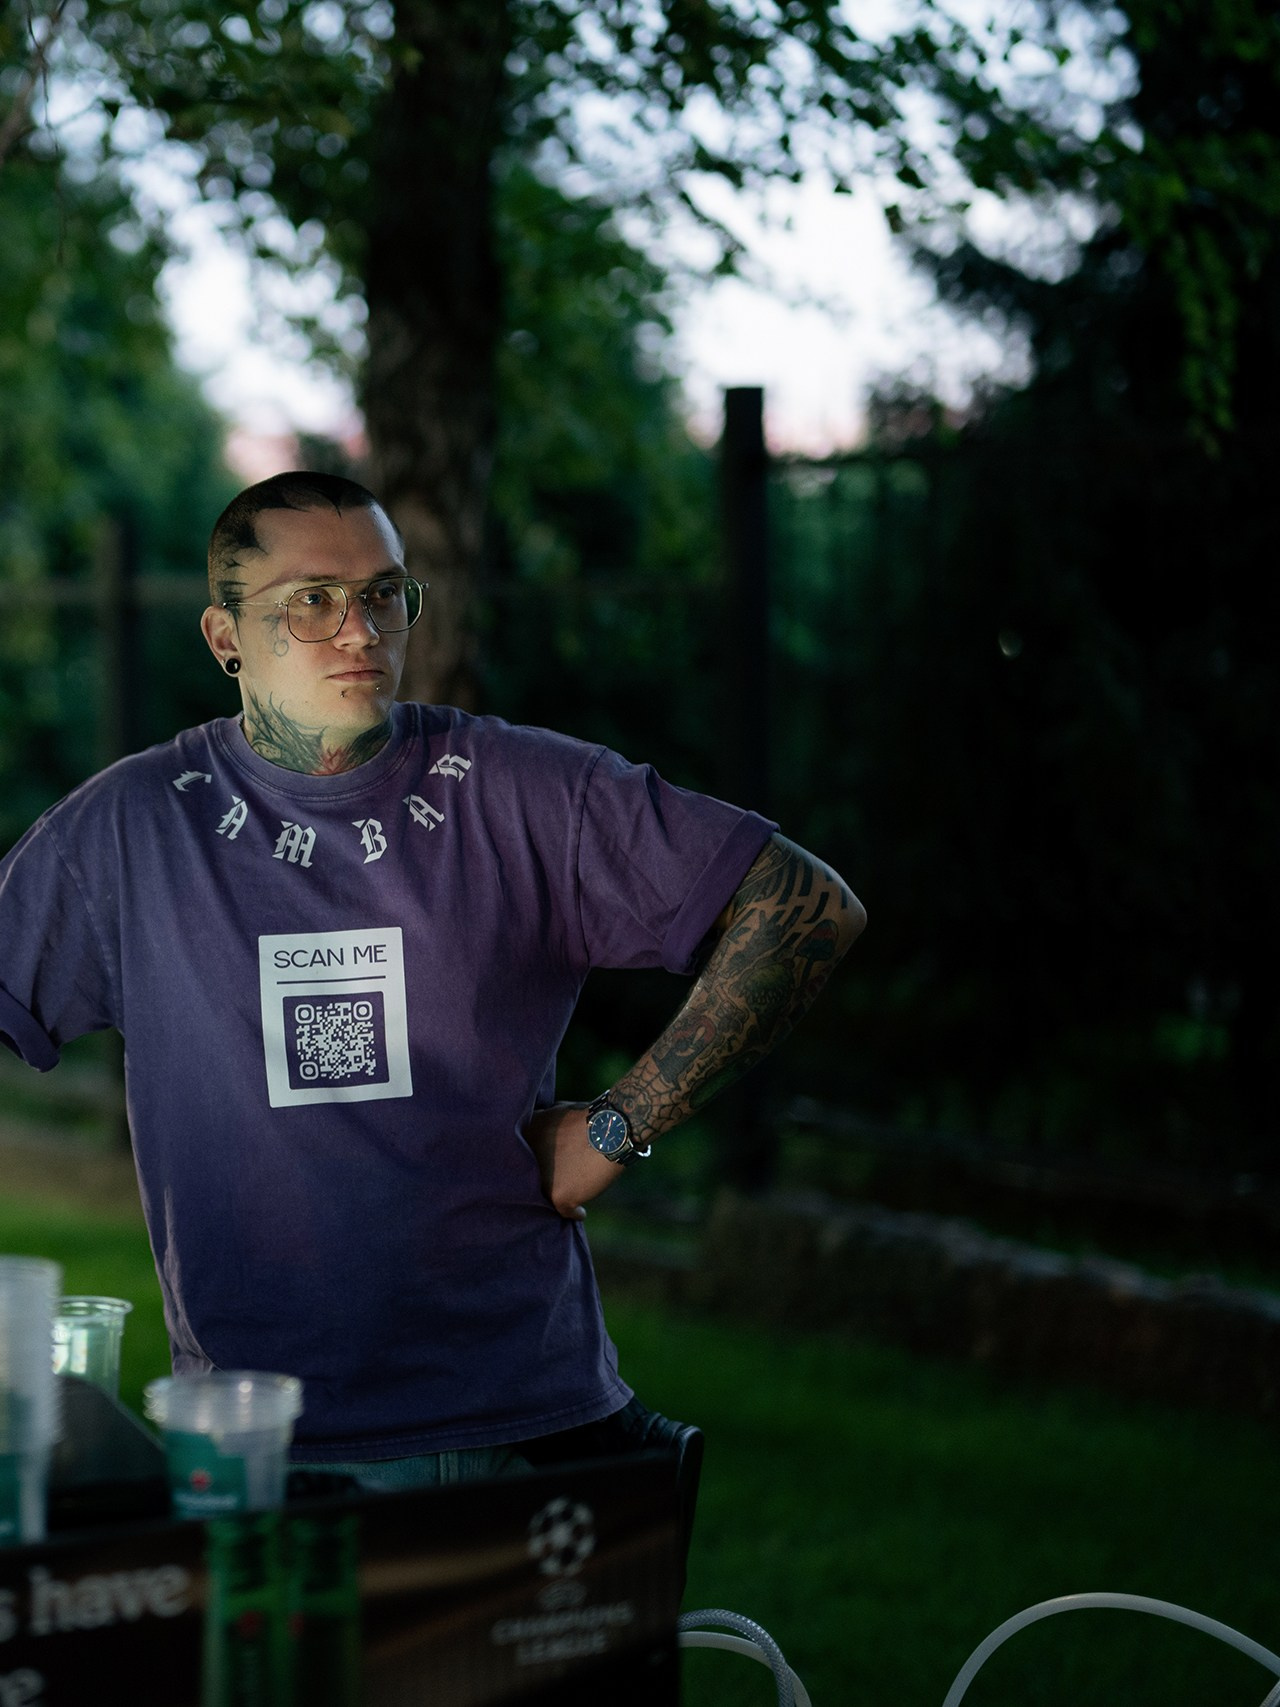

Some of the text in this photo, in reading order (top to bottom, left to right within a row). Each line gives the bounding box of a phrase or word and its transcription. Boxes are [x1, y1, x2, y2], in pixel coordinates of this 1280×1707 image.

[273, 944, 388, 970] SCAN ME
[26, 1563, 191, 1637] have
